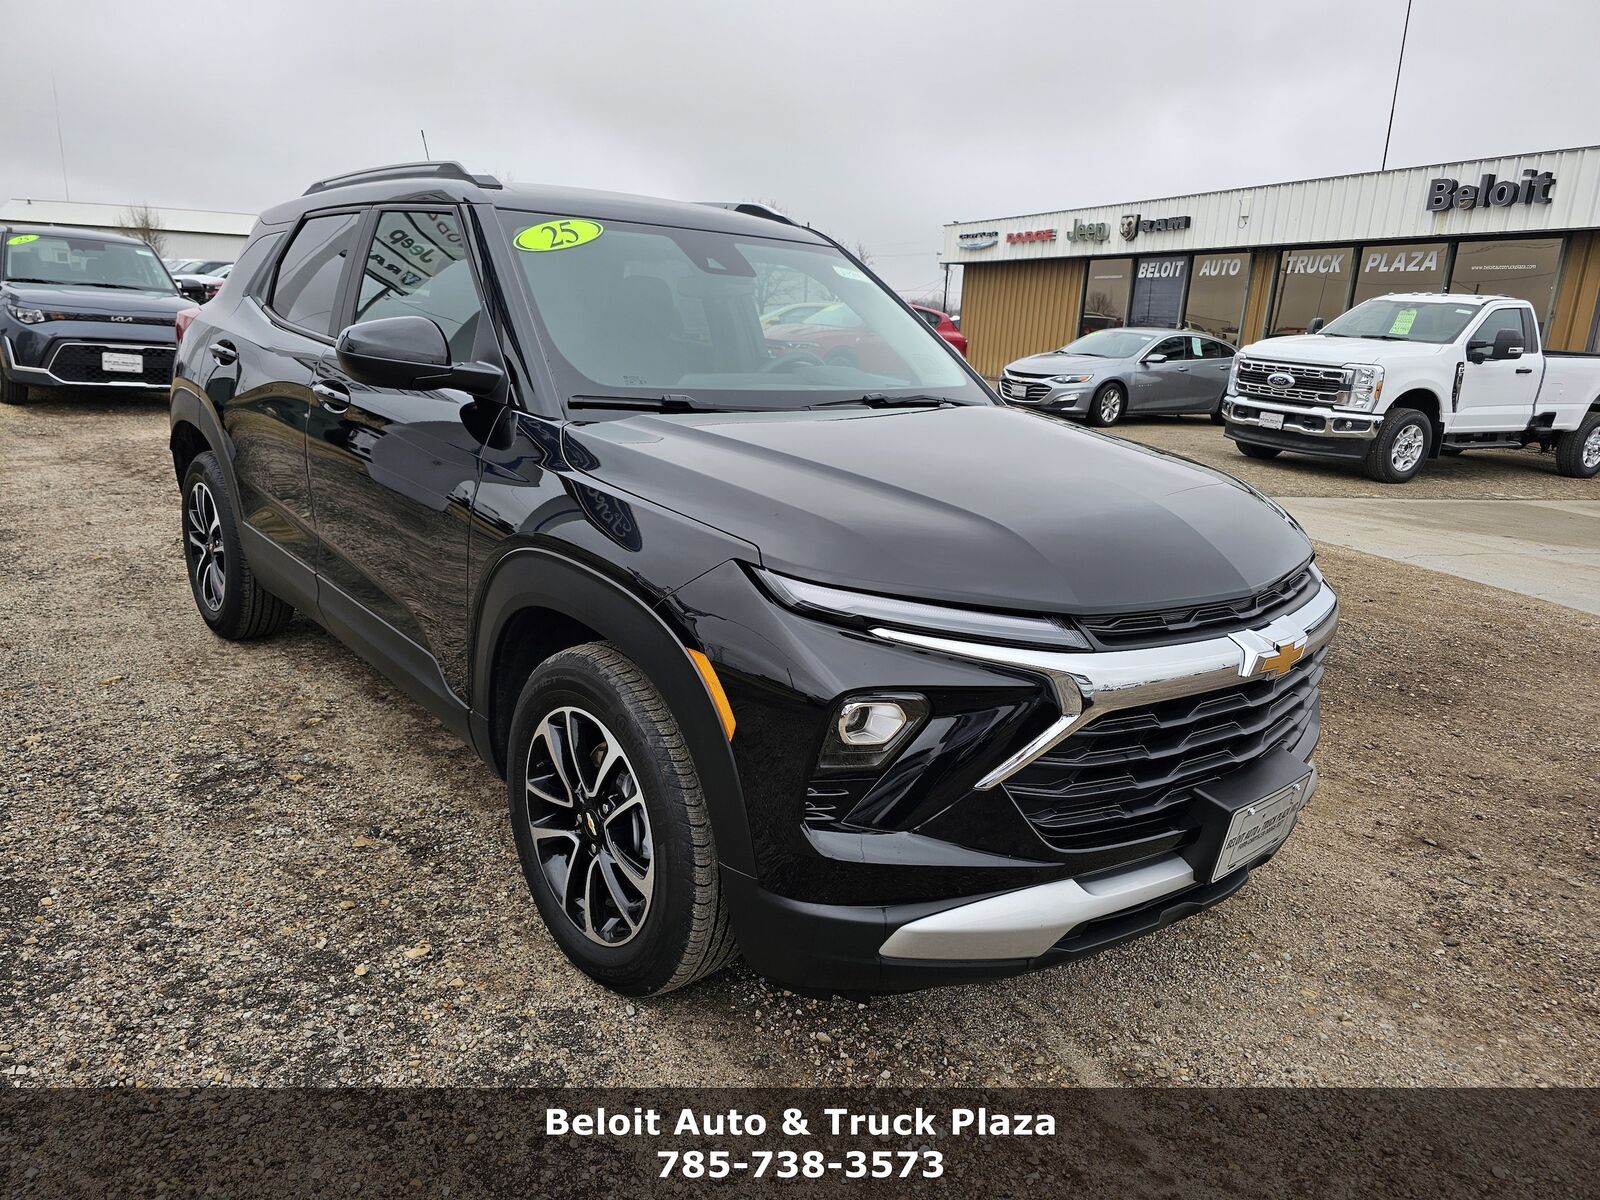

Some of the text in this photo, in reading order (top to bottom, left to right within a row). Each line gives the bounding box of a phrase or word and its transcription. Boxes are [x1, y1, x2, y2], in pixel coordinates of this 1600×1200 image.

[1426, 169, 1556, 212] Beloit
[541, 221, 579, 248] 25
[1006, 229, 1056, 244] DODGE
[1066, 218, 1111, 245] Jeep
[1138, 216, 1190, 233] RAM
[1138, 250, 1437, 278] BELOIT AUTO TRUCK PLAZA
